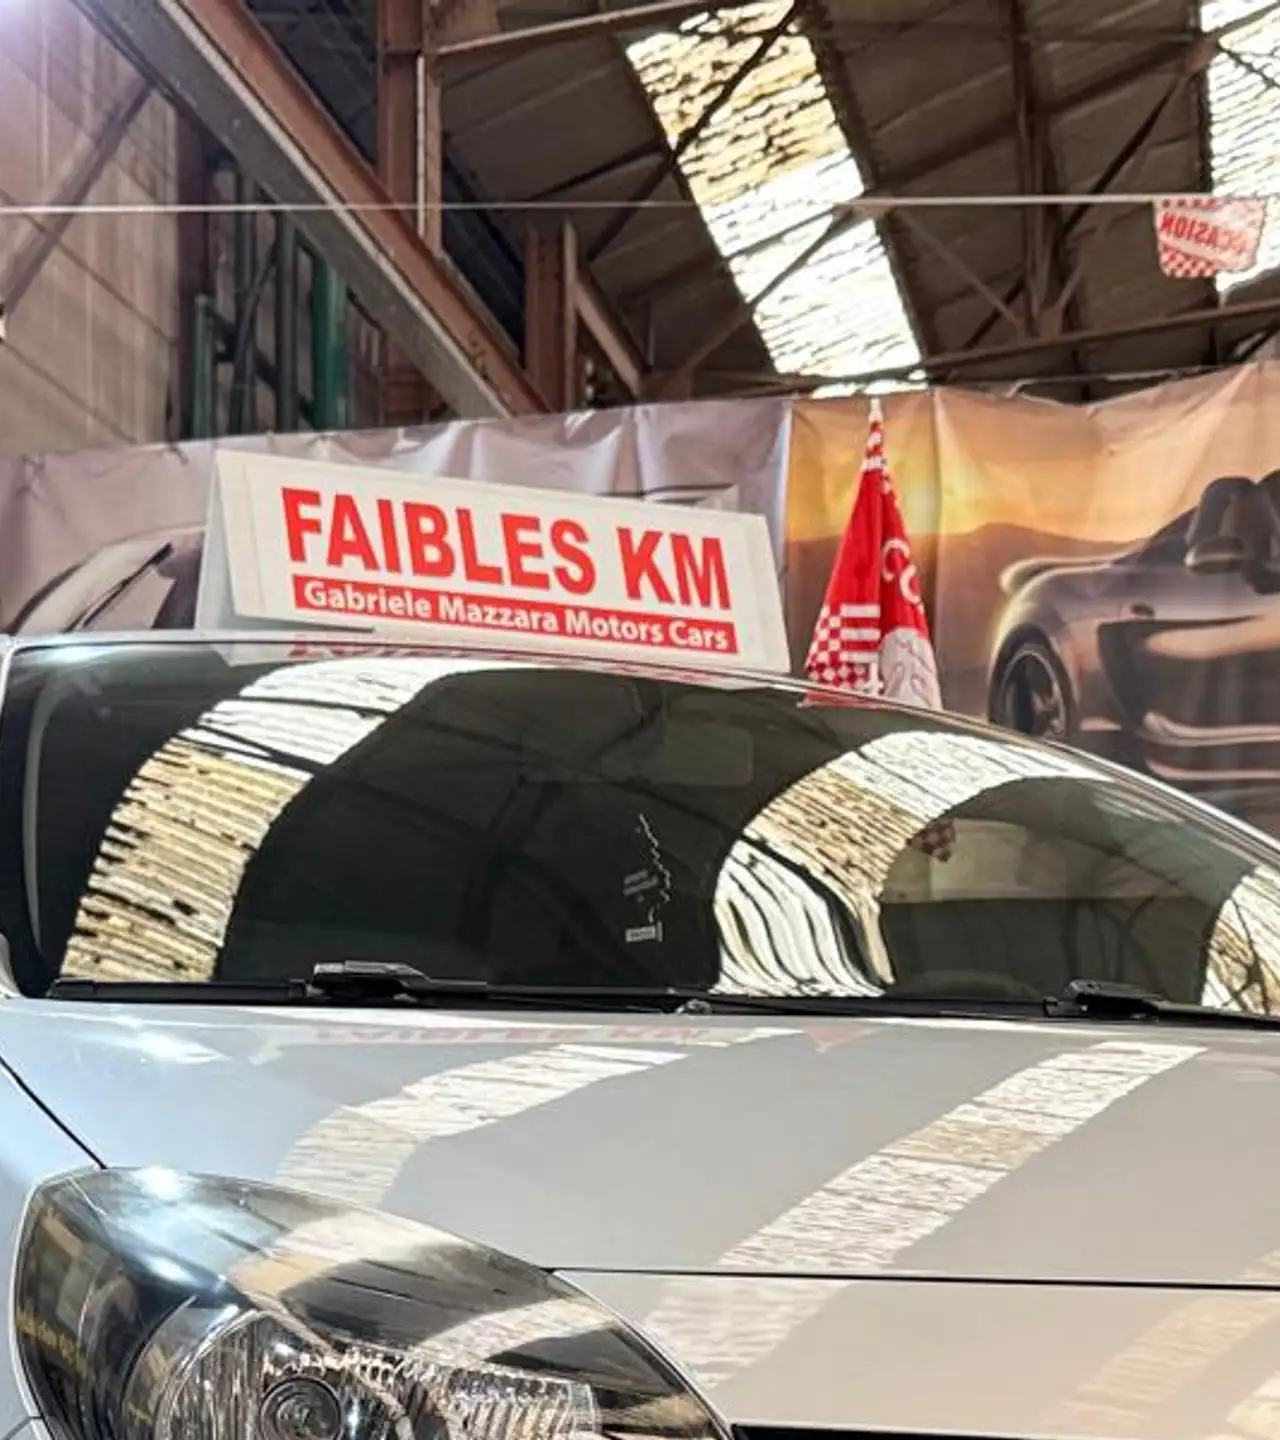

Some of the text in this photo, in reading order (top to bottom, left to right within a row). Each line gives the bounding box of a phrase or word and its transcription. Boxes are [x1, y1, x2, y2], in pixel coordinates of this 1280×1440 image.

[281, 486, 732, 611] FAIBLES KM
[303, 580, 729, 650] Gabriele Mazzara Motors Cars
